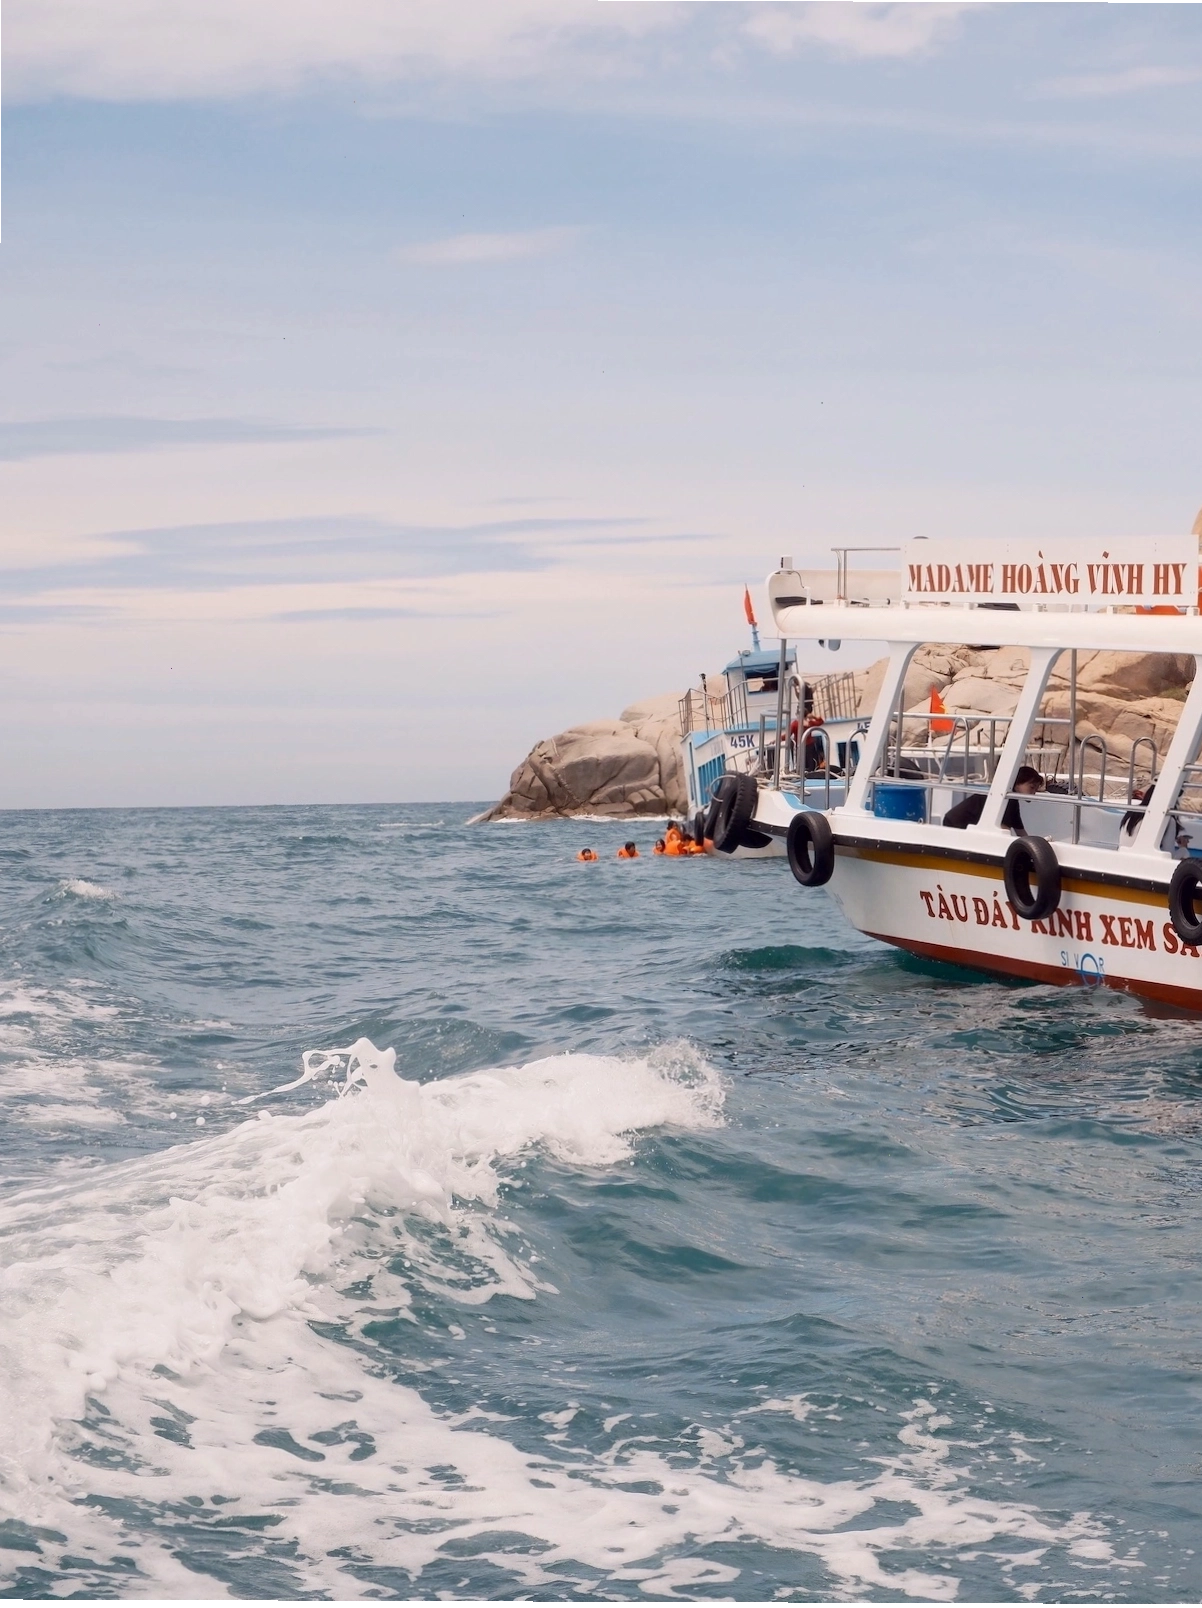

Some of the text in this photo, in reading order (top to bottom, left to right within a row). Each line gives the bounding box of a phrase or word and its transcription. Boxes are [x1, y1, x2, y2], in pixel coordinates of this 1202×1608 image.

[908, 562, 994, 594] MADAME
[1001, 550, 1080, 595] HOÀNG
[1152, 562, 1188, 596] HY
[730, 734, 755, 749] 45K
[919, 884, 968, 923] TÀU
[1099, 914, 1157, 951] XEM
